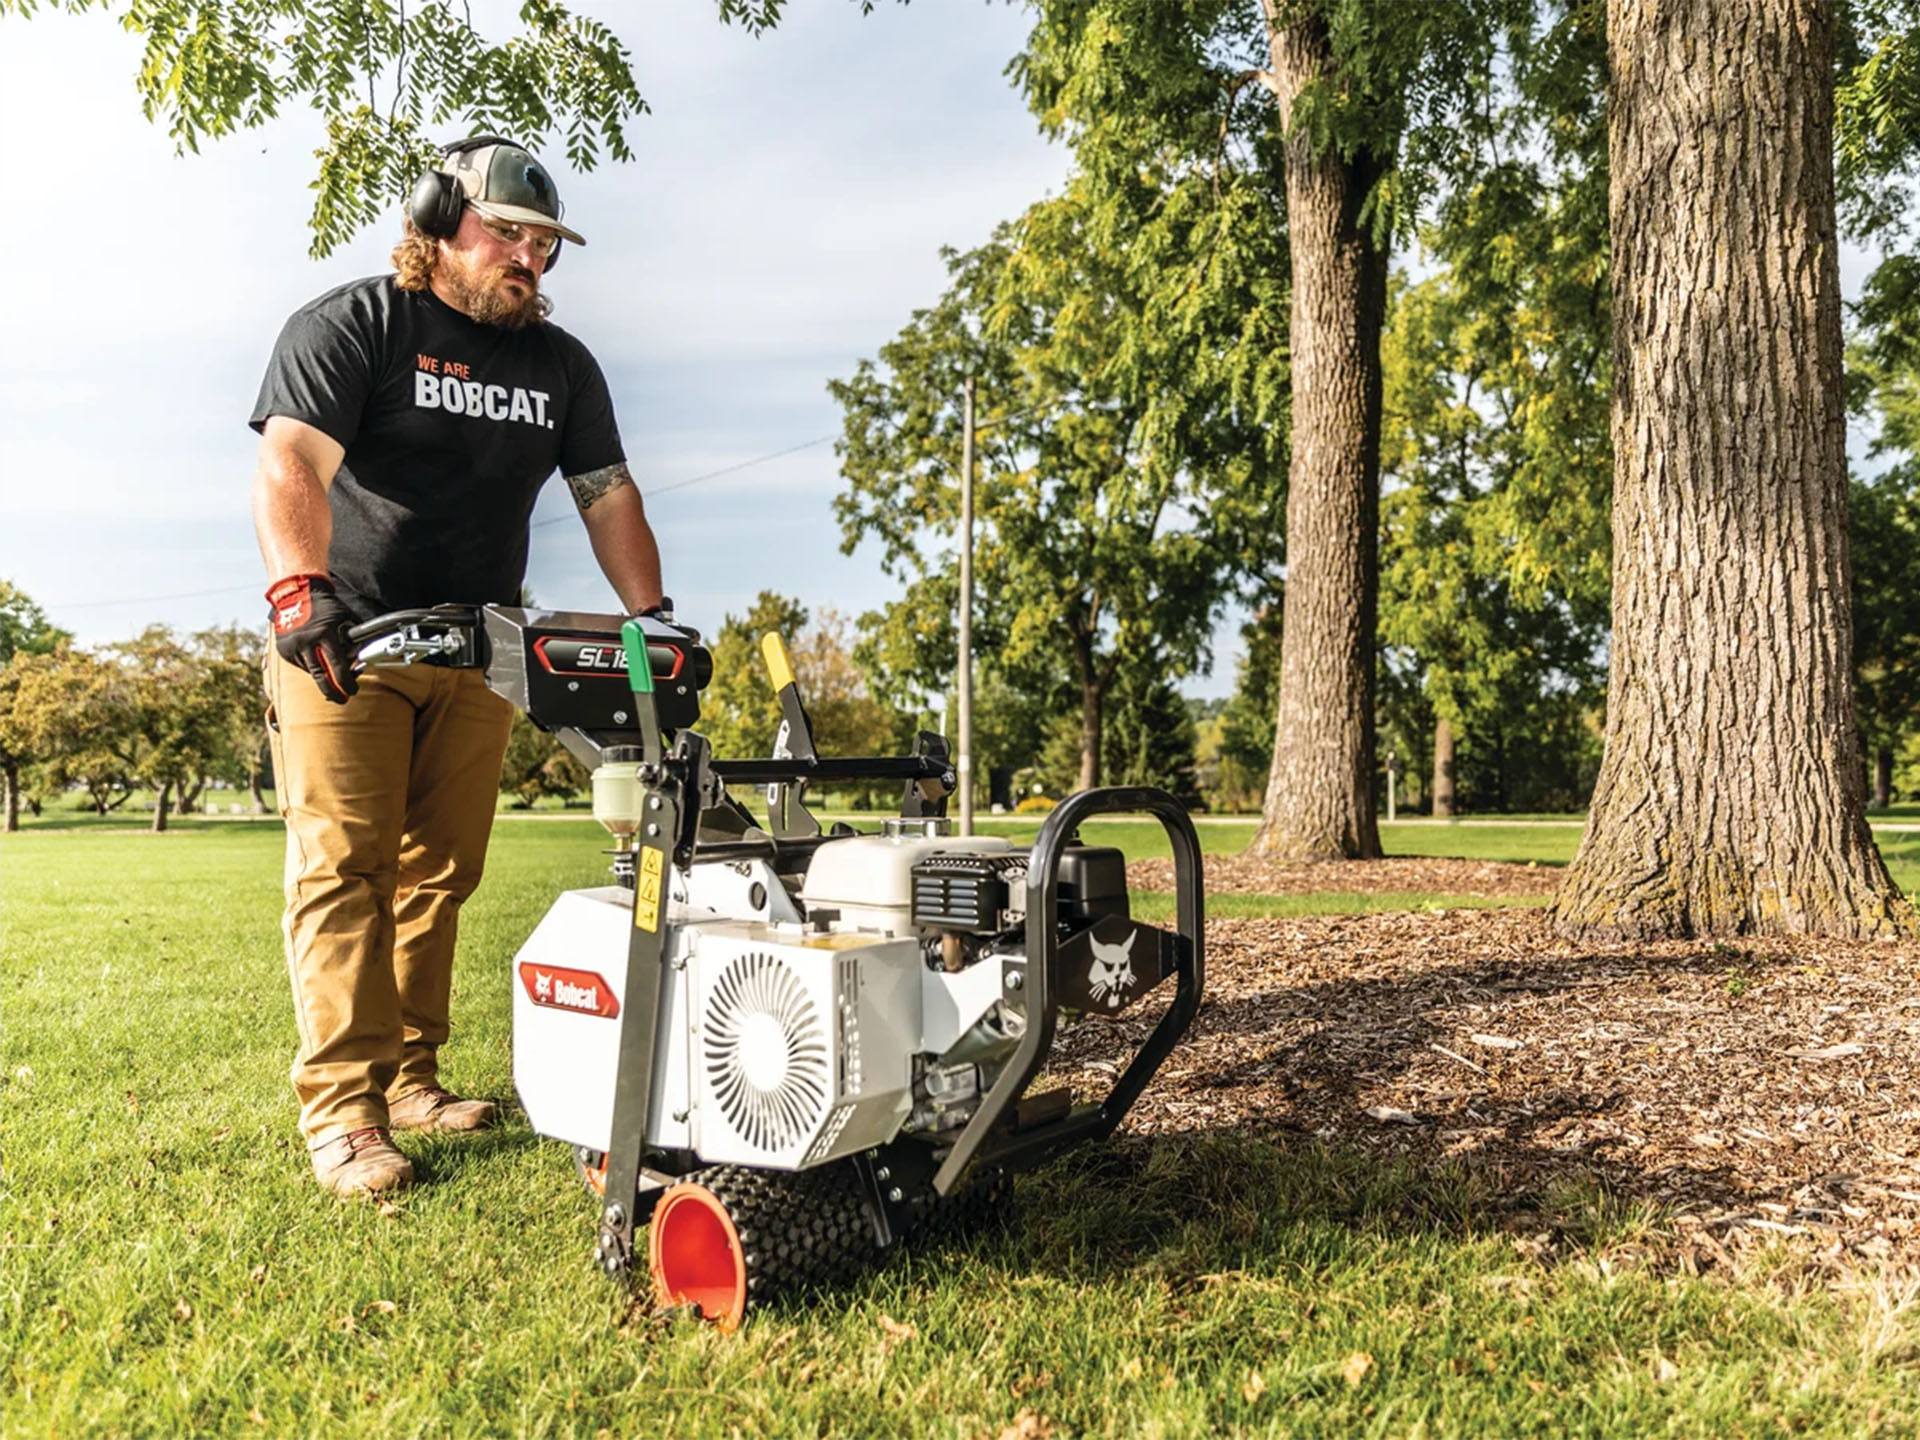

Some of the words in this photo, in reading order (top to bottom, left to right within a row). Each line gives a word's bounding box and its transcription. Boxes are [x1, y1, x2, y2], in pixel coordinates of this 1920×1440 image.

[417, 354, 440, 374] WE
[443, 361, 471, 380] ARE
[415, 371, 554, 429] BOBCAT.
